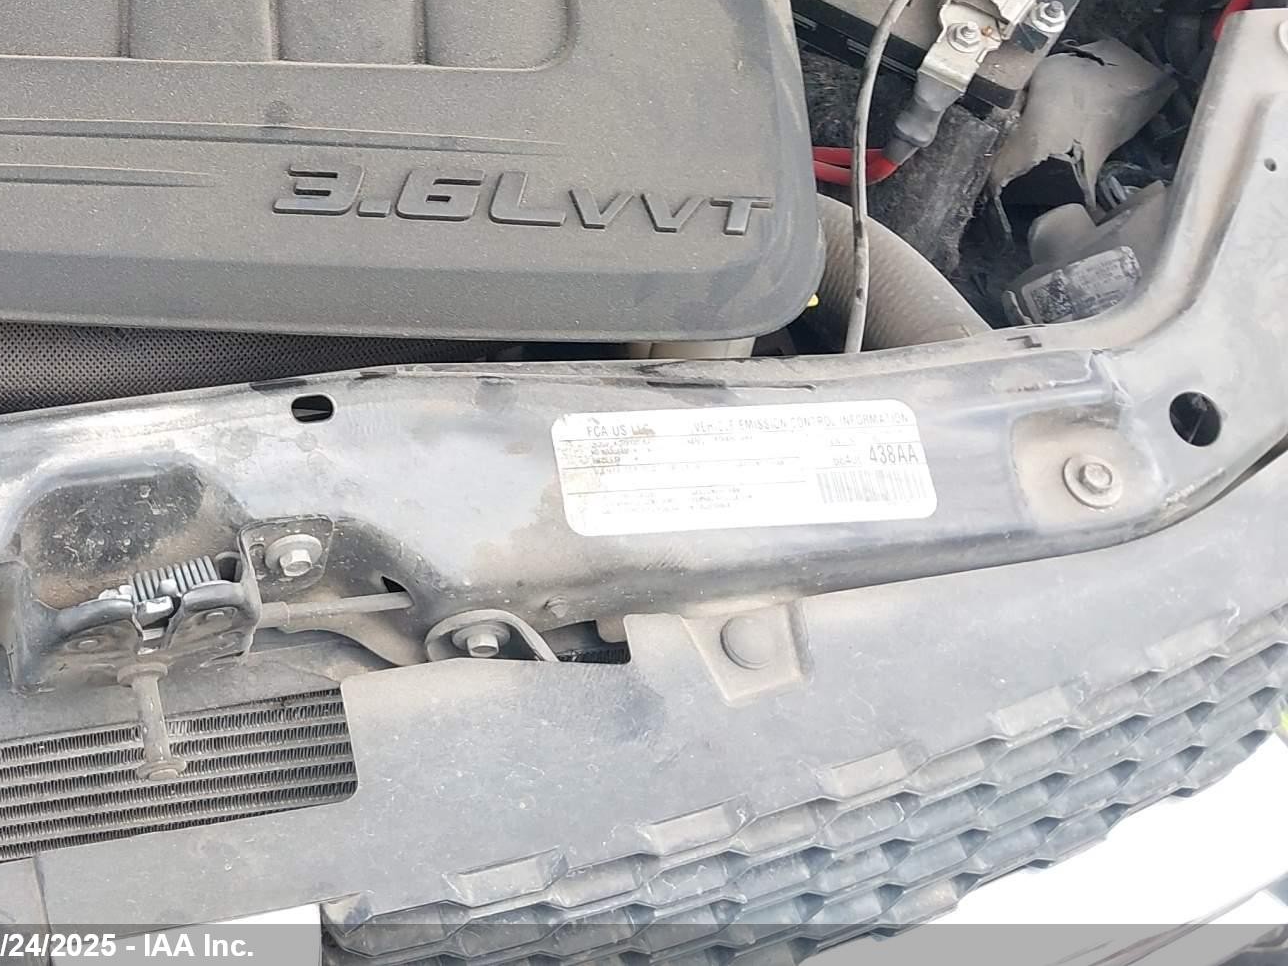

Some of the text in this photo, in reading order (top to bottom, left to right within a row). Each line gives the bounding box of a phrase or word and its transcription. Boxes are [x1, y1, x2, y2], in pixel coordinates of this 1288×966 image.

[586, 425, 608, 437] FCA
[612, 424, 627, 436] US
[738, 417, 787, 431] EMISSION
[869, 443, 919, 465] 438AA
